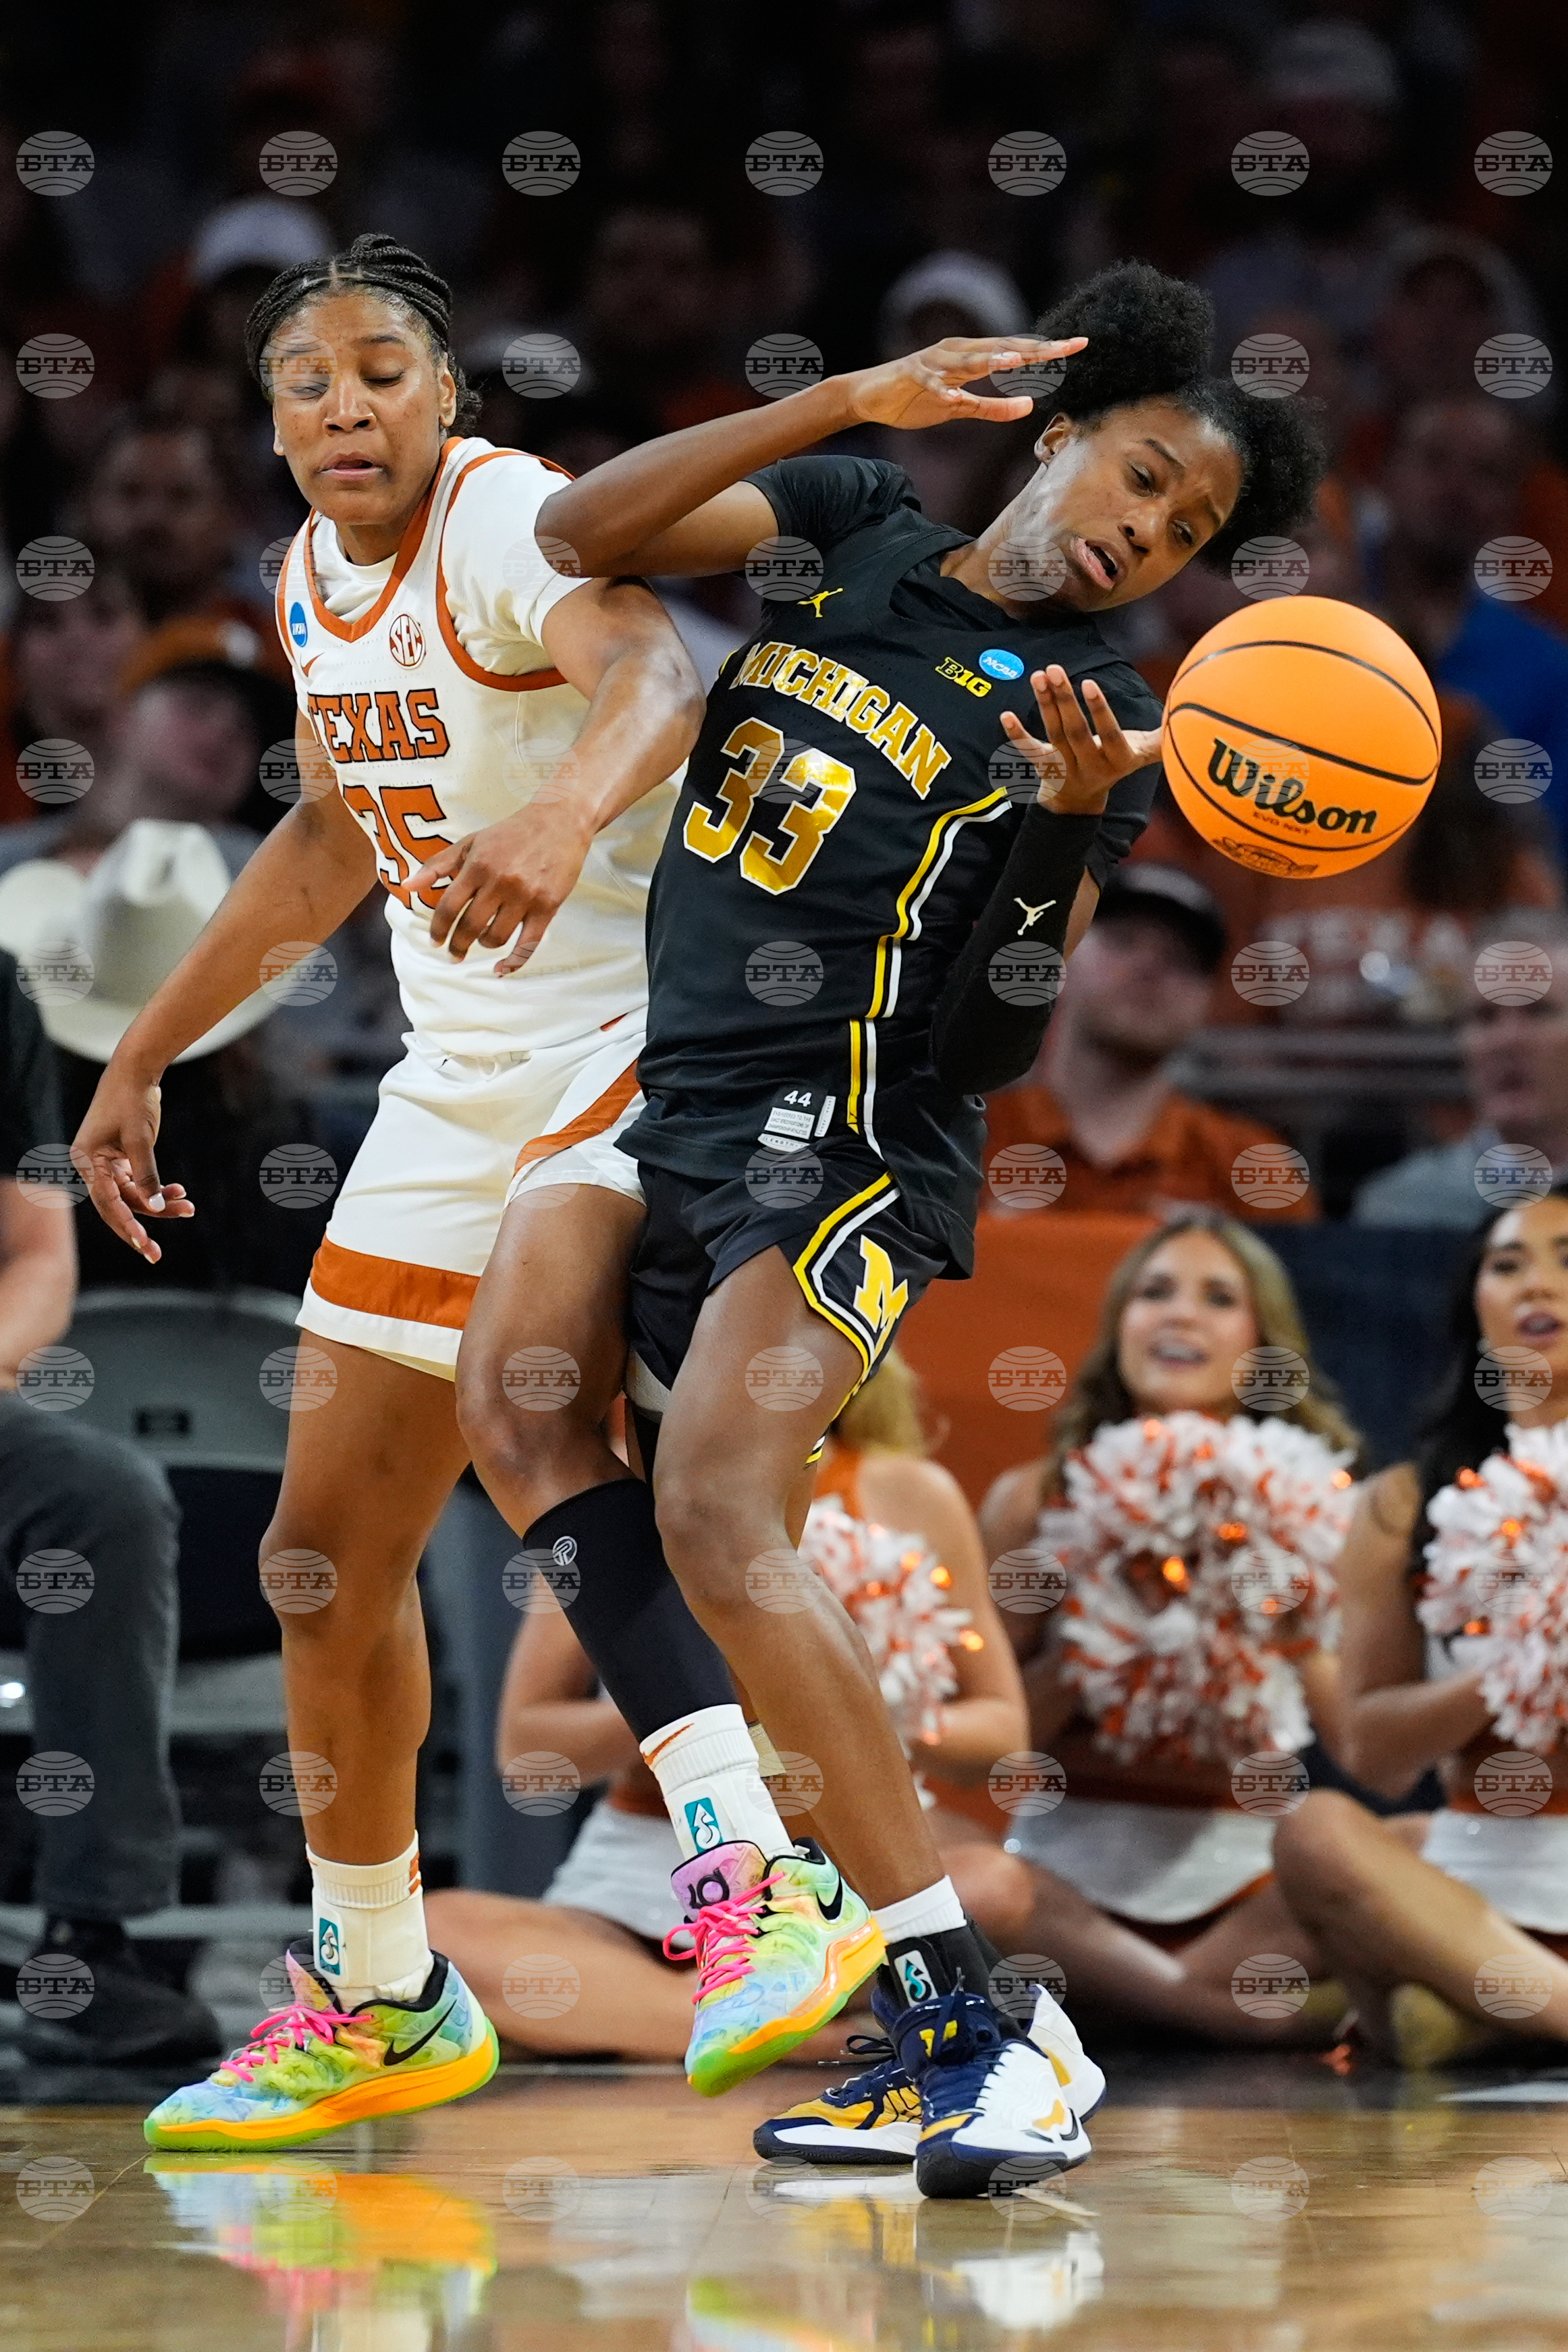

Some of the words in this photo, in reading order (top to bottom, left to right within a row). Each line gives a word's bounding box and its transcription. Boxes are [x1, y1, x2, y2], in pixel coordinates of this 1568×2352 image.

[390, 615, 423, 666] SEC
[983, 656, 1018, 678] NCAA
[308, 688, 450, 764] TEXAS
[729, 641, 952, 800] MICHIGAN
[683, 717, 857, 896] 33
[1208, 737, 1377, 834] Wilson
[784, 1090, 812, 1107] 44
